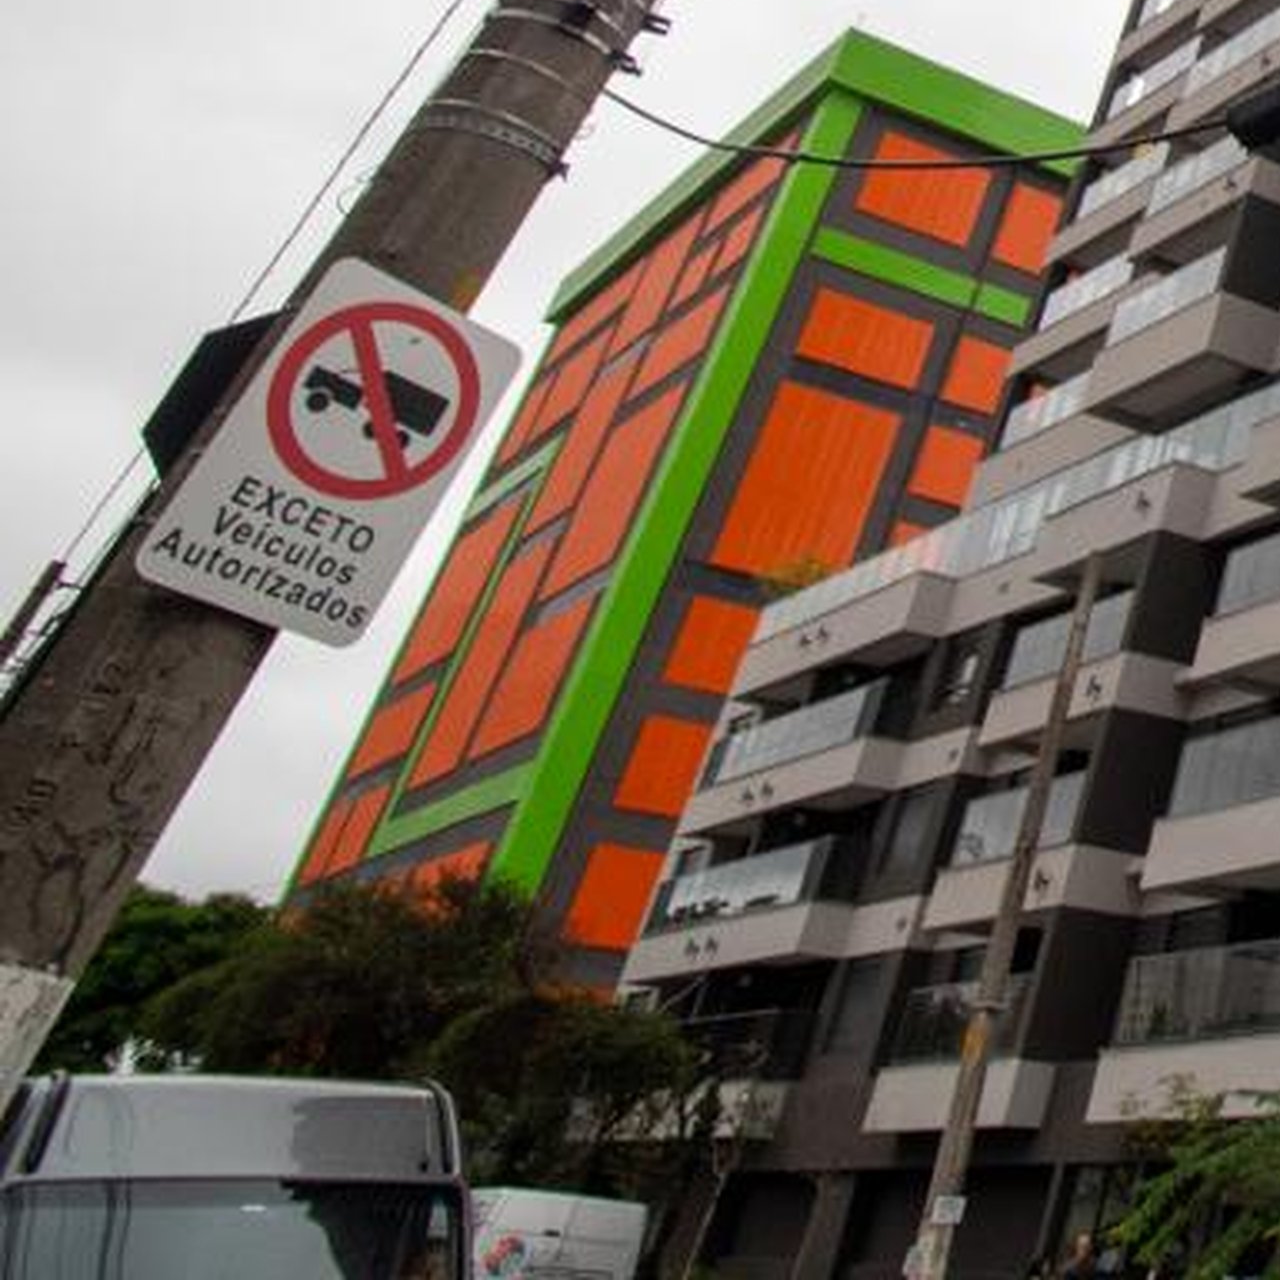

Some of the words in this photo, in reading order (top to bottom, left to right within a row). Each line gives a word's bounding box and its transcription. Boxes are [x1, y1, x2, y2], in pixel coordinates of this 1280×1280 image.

[213, 506, 359, 585] Veículos
[230, 475, 375, 553] EXCETO
[152, 528, 369, 629] Autorizados
